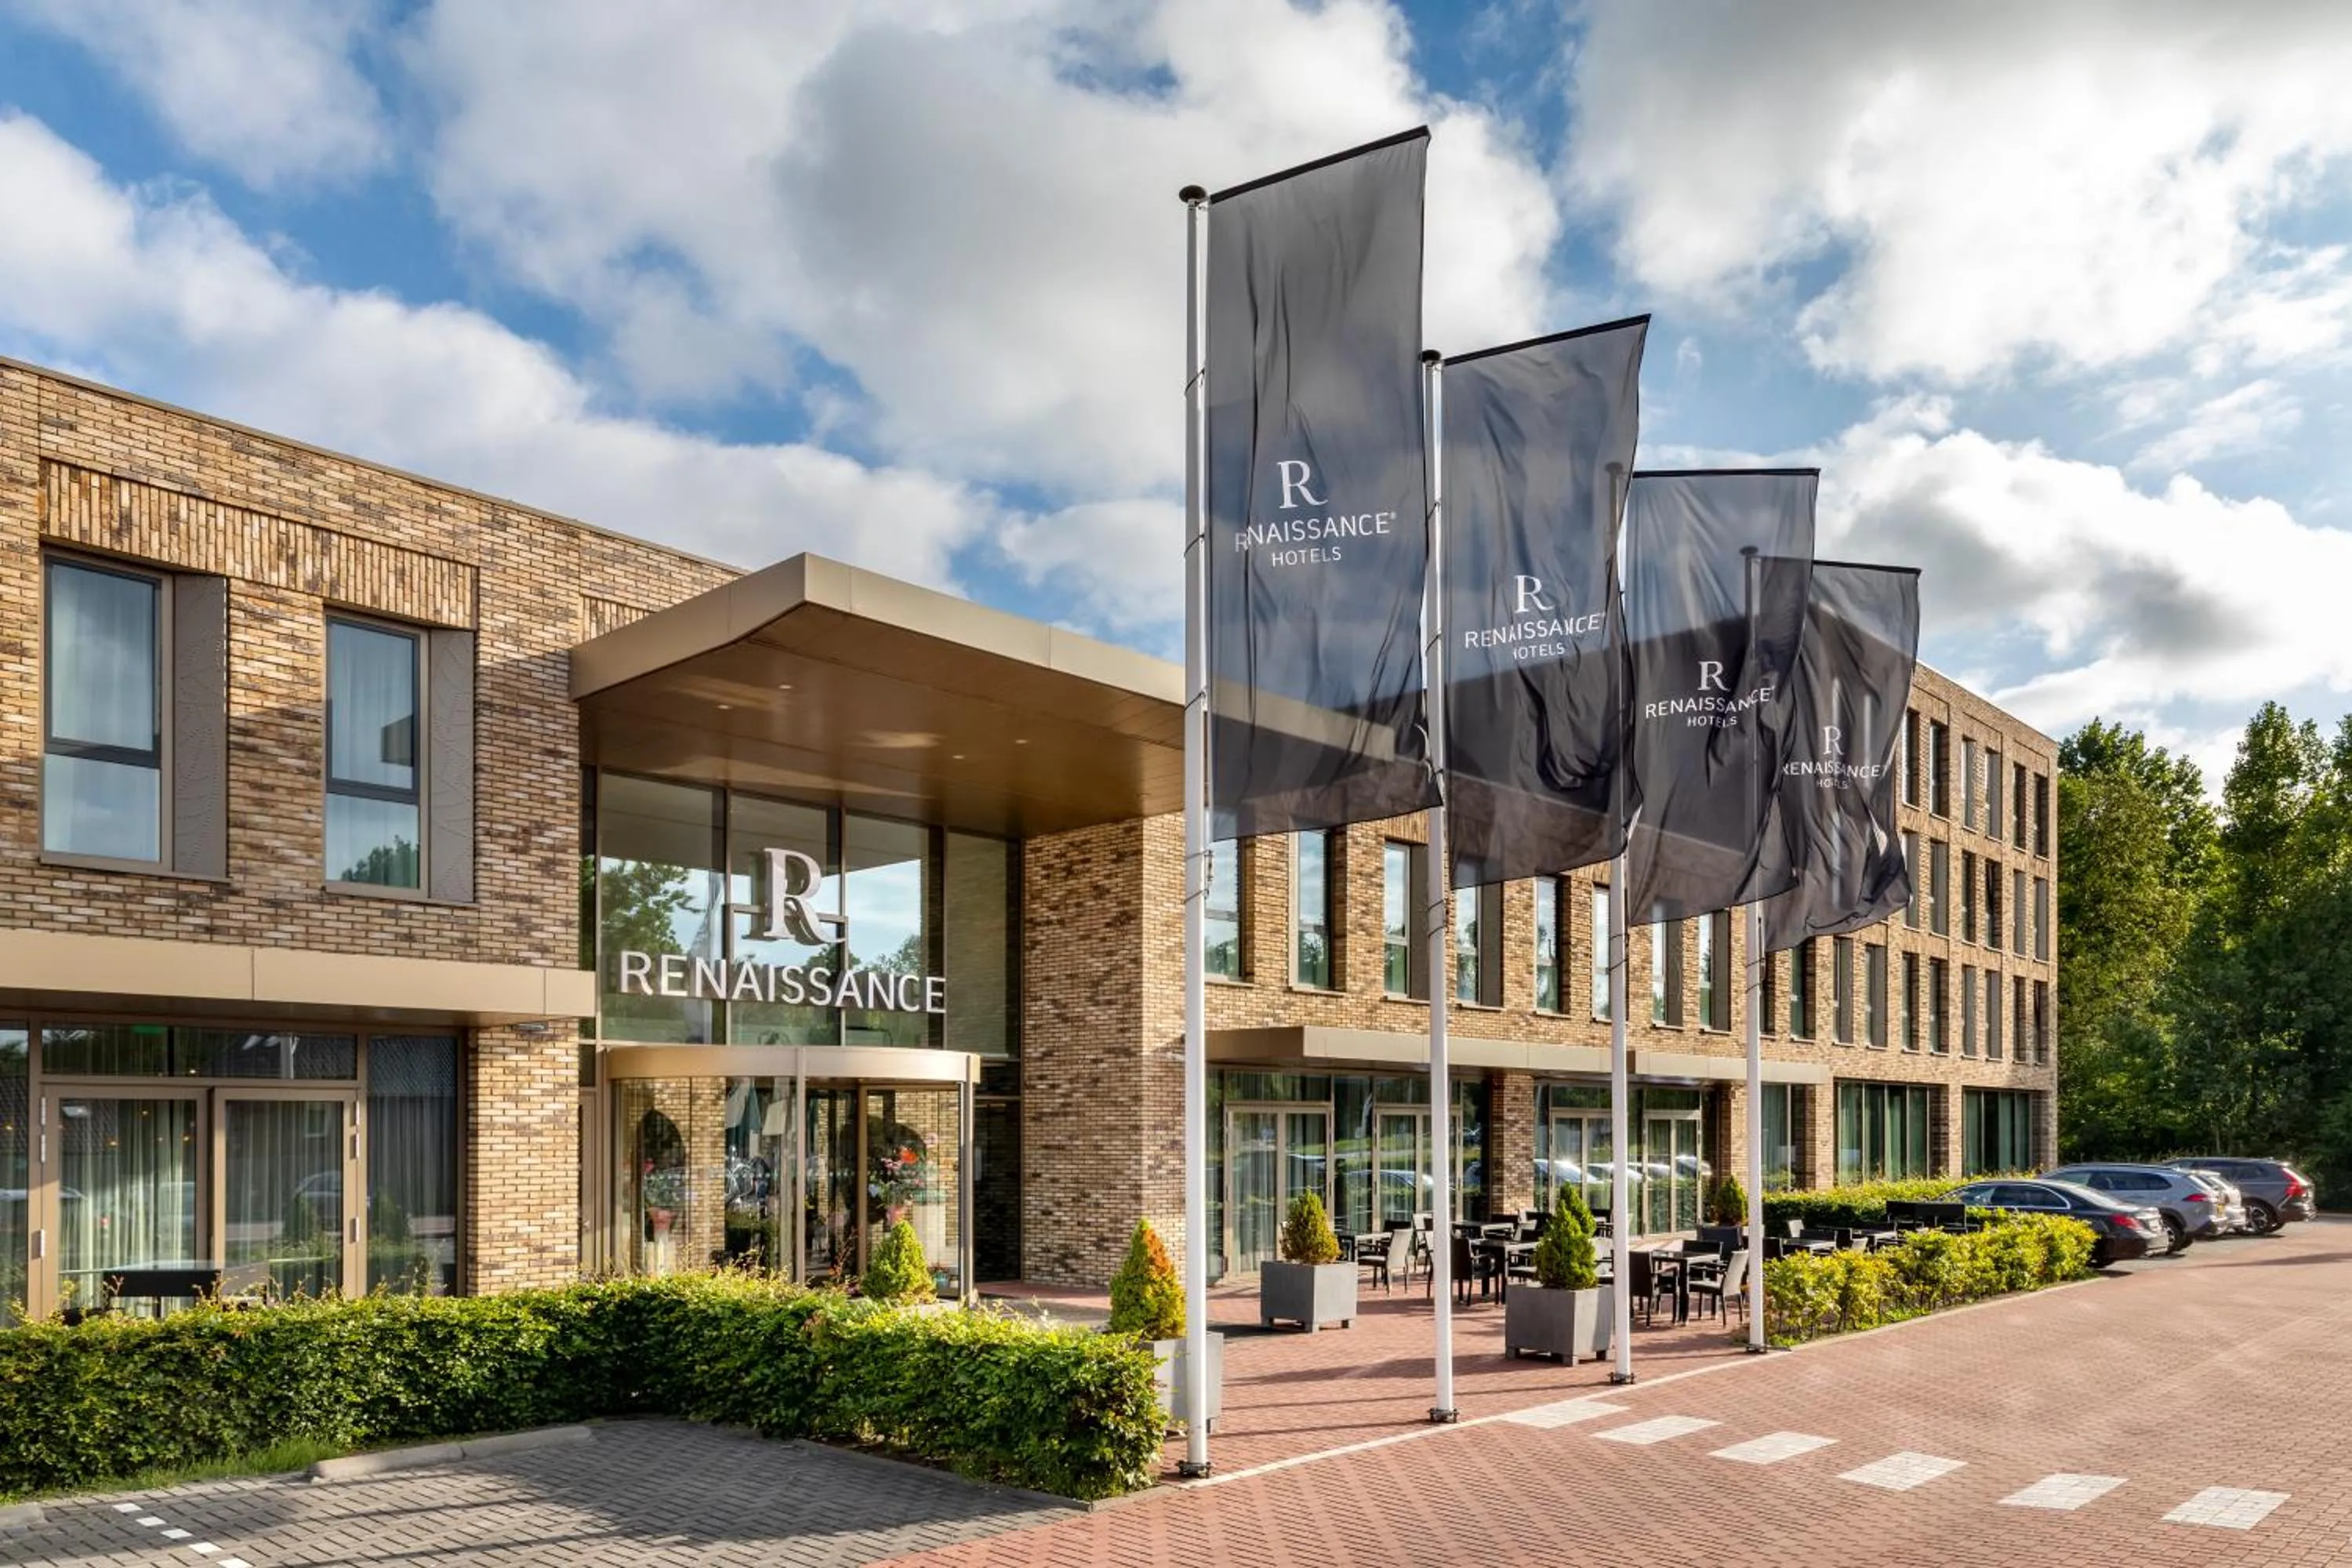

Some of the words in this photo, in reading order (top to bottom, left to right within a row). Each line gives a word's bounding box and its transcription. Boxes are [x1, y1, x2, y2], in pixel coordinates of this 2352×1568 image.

[1276, 460, 1329, 509] R
[1235, 512, 1391, 553] RNAISSANCE
[1272, 546, 1341, 567] HOTELS
[1514, 575, 1555, 613] R
[1697, 661, 1730, 691] R
[1646, 687, 1772, 719] RENAISSANCE
[1686, 715, 1737, 728] HOTELS
[1823, 725, 1844, 755] R
[1817, 778, 1849, 789] HOLS
[763, 848, 846, 946] R
[620, 950, 946, 1013] RENAISSANCE
